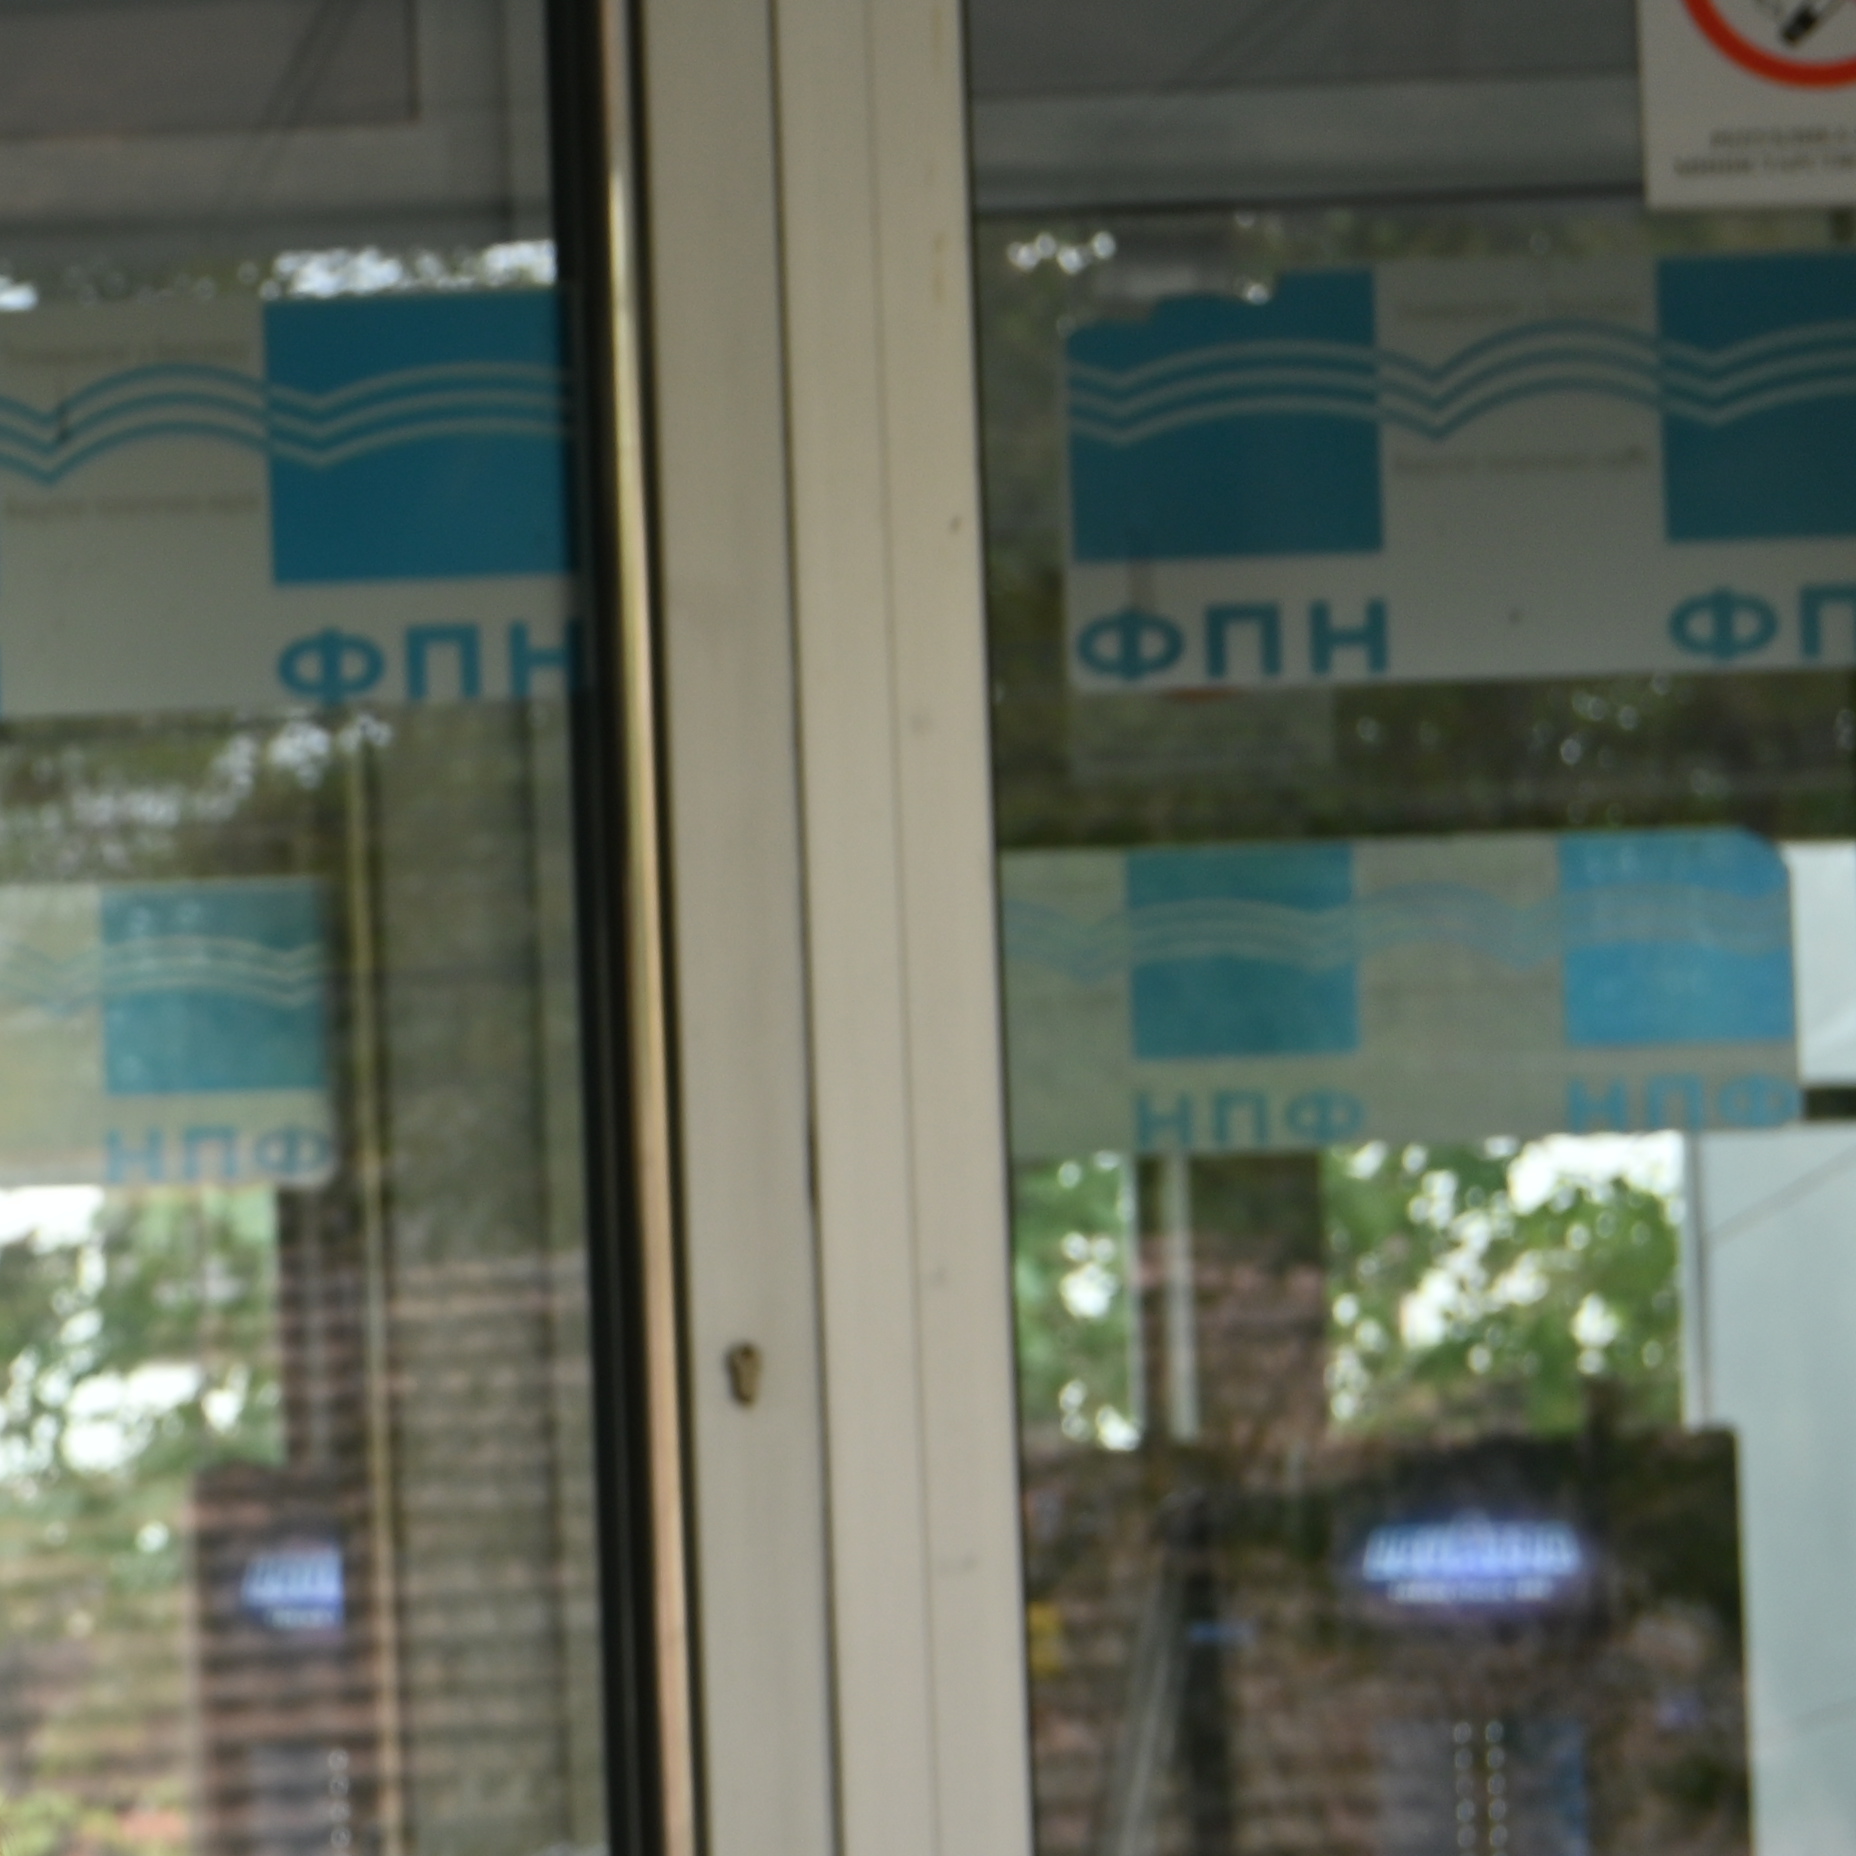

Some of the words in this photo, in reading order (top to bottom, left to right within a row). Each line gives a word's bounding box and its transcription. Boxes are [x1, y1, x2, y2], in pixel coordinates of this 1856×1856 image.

[276, 616, 584, 706] ФПН
[1076, 597, 1390, 681] ФПН
[1668, 580, 1856, 664] ФП
